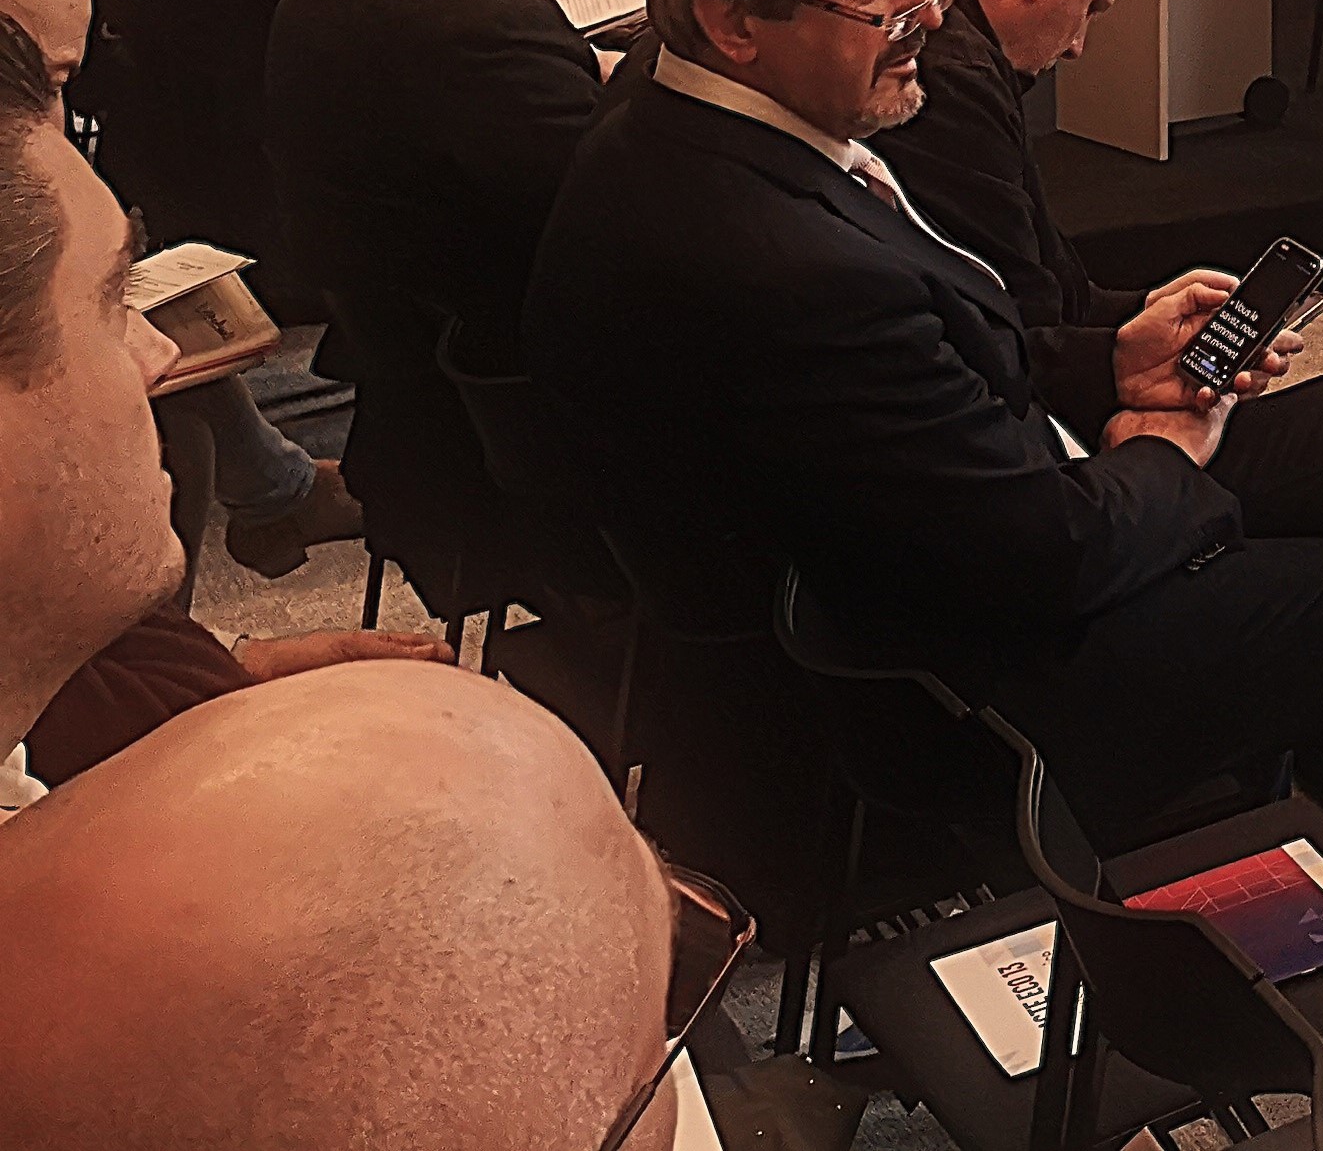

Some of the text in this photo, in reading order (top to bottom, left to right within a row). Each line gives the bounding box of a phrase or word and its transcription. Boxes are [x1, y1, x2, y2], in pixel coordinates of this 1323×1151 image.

[1201, 332, 1212, 343] un
[1210, 321, 1239, 344] sommes
[1240, 323, 1258, 339] nous
[997, 961, 1049, 1029] CTE ECO 13
